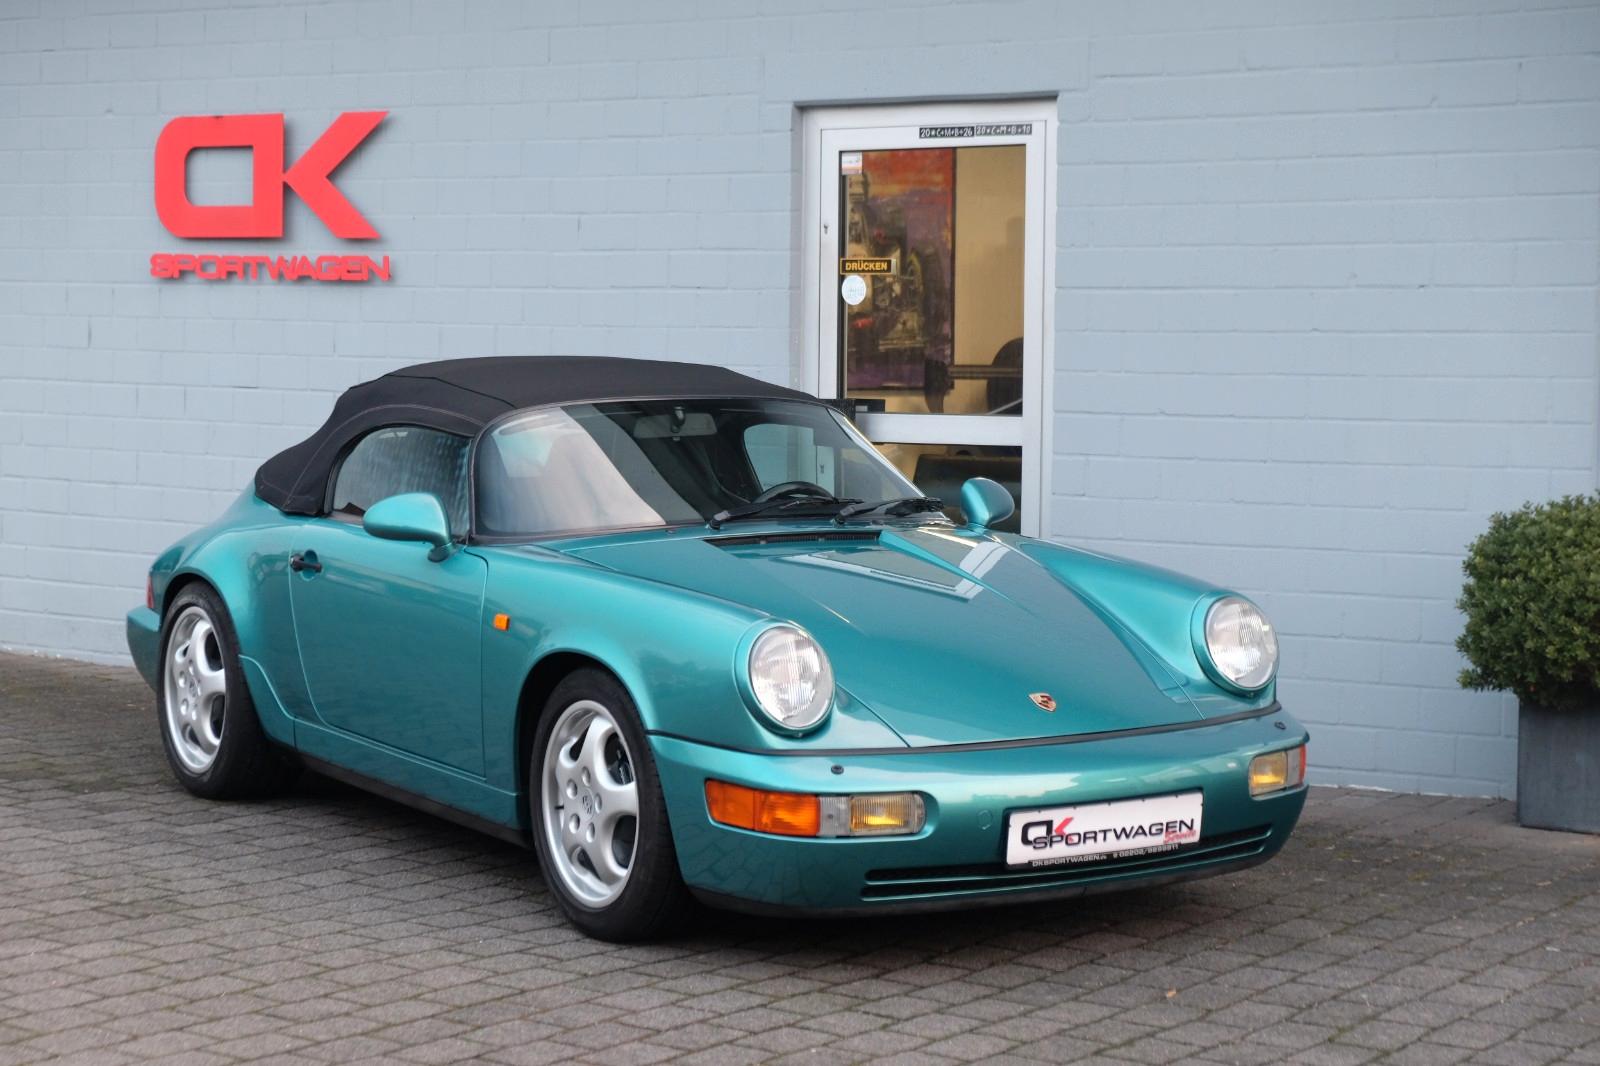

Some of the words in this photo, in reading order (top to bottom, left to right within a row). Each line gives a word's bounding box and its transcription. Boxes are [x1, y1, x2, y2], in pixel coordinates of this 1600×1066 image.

[155, 112, 390, 240] DK
[150, 254, 390, 282] SPORTWAGEN
[845, 261, 888, 272] DRÜCKEN
[1032, 818, 1194, 849] SPORTWAGEN
